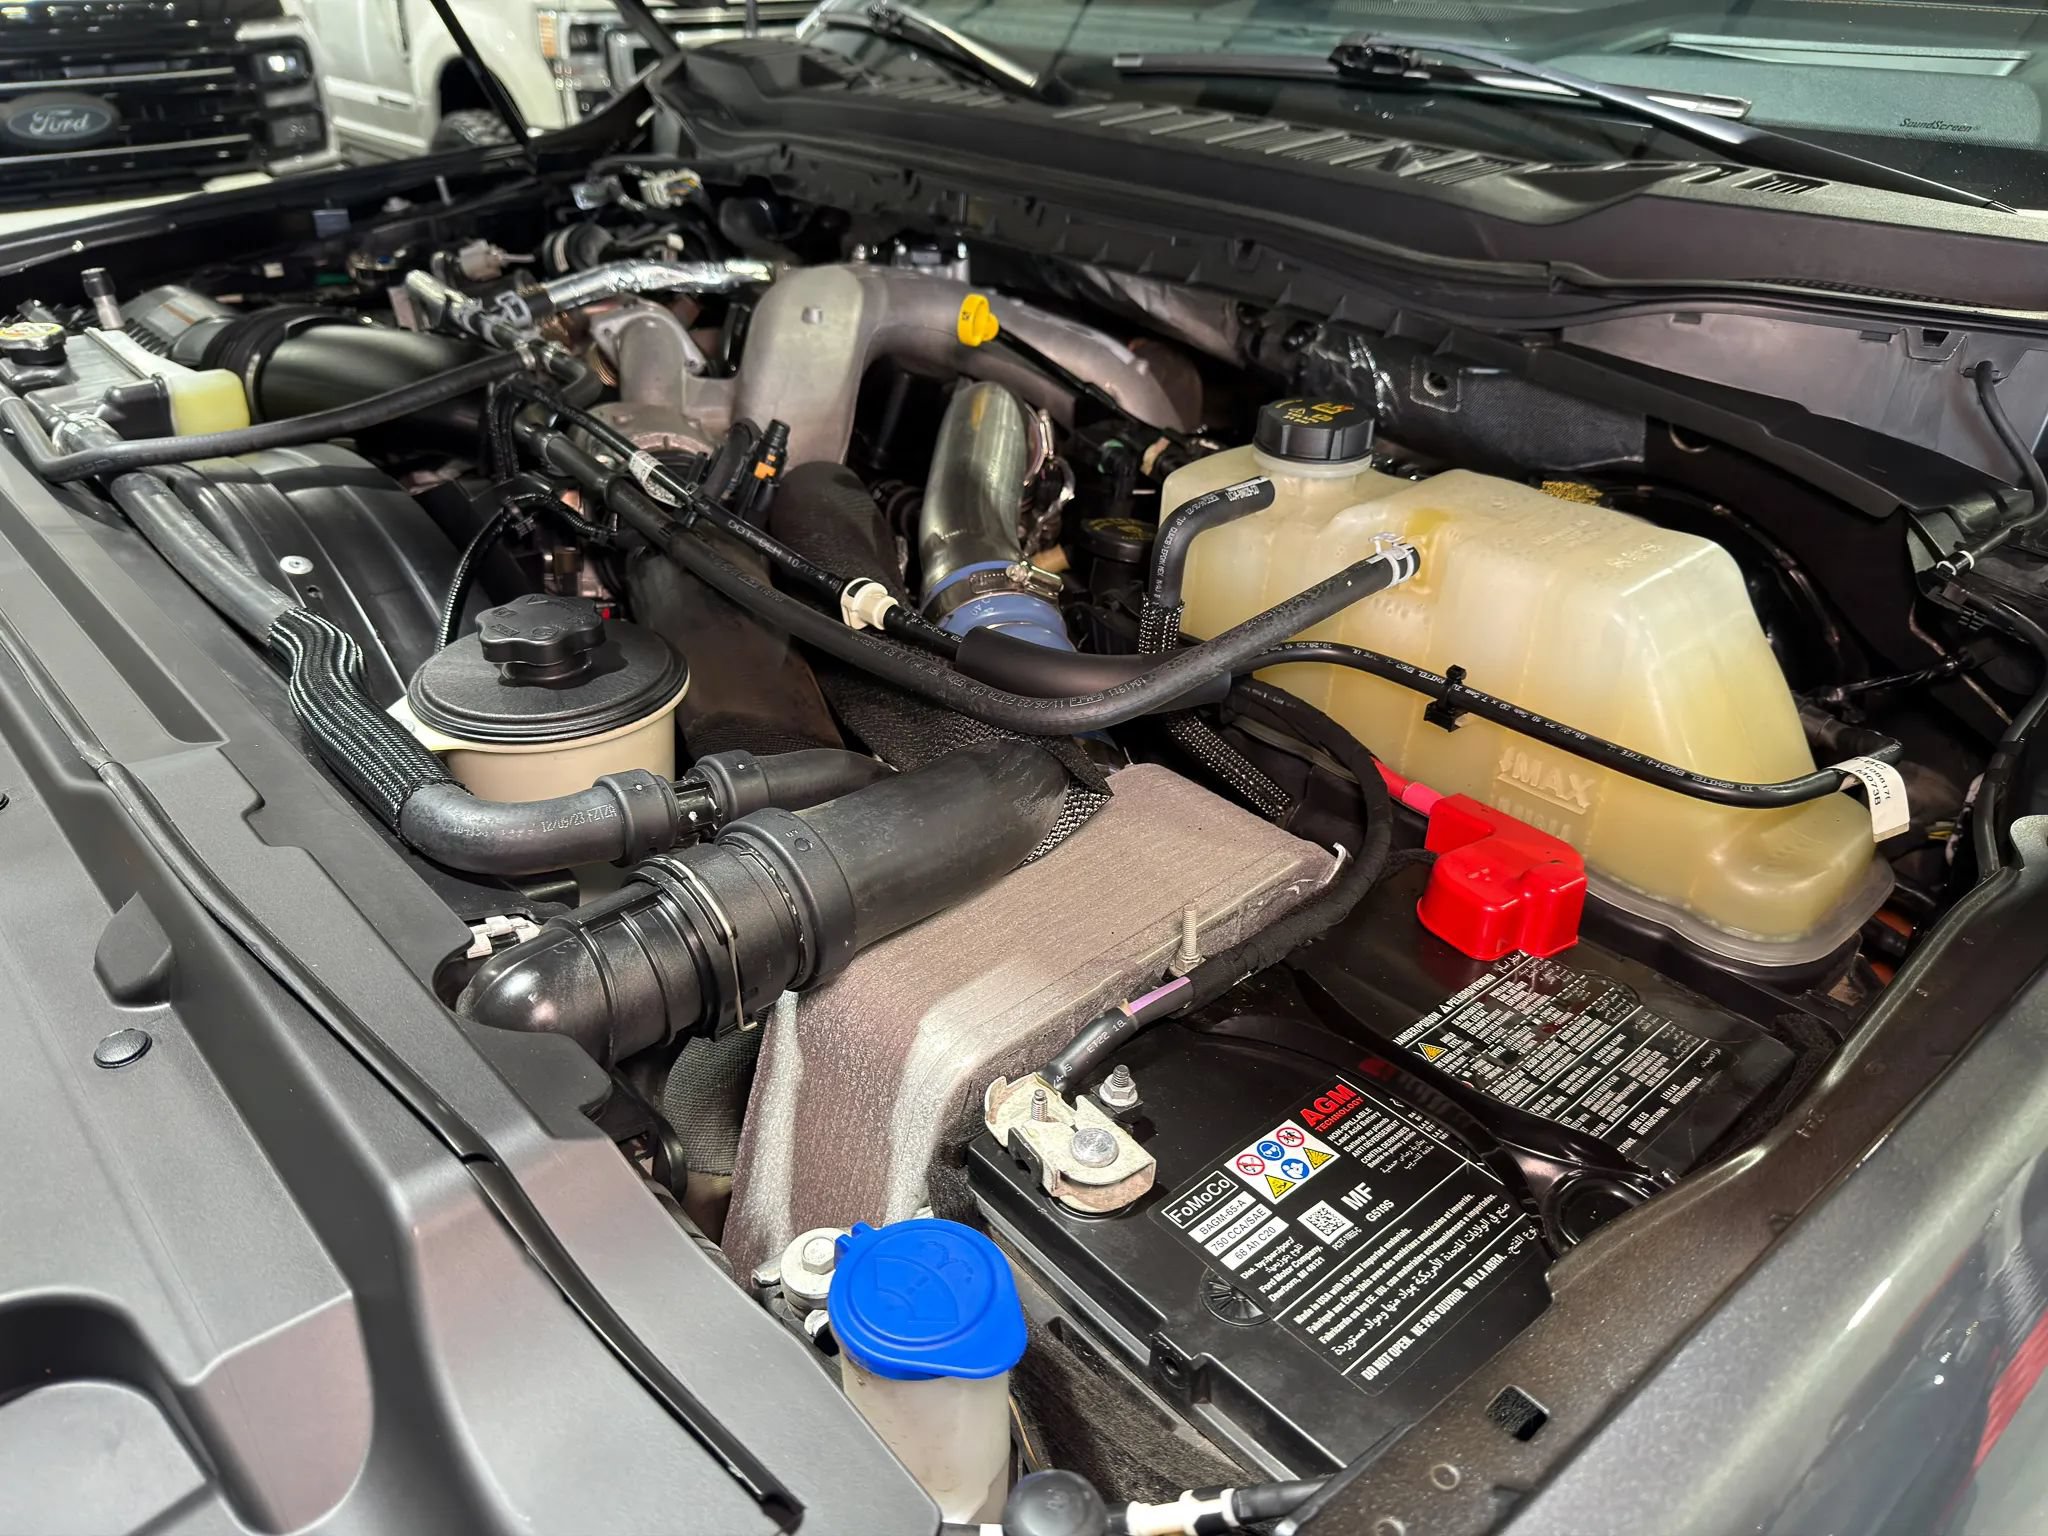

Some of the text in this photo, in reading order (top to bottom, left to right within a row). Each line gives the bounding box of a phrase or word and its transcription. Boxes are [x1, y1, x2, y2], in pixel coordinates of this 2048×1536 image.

[29, 109, 90, 136] Ford
[1300, 1084, 1355, 1126] AGM
[1315, 1096, 1362, 1131] TECHNOLOGY
[1327, 1107, 1372, 1141] NON-SPILLABLE
[1333, 1111, 1381, 1145] Lead Acid Battery
[1343, 1135, 1366, 1152] Batterie
[1371, 1117, 1389, 1132] plomb
[1351, 1145, 1366, 1157] ANTI
[1360, 1146, 1384, 1163] CONTRA
[1380, 1126, 1409, 1148] DERRAMES
[1169, 1179, 1229, 1222] FoMoCo
[1340, 1182, 1372, 1210] MF
[1365, 1199, 1394, 1221] G519S
[1495, 1203, 1510, 1218] صنع
[1199, 1199, 1246, 1234] BAGM-65-A
[1210, 1208, 1266, 1250] 750 CCA/SAE
[1464, 1218, 1489, 1242] الولايات
[1486, 1212, 1500, 1223] في
[1234, 1226, 1276, 1259] 68 Ah C20
[1349, 1309, 1360, 1319] en
[1355, 1302, 1369, 1312] los
[1364, 1294, 1379, 1304] EE.
[1374, 1285, 1389, 1296] UU.
[1386, 1275, 1399, 1286] con
[1396, 1253, 1426, 1278] materiales
[1423, 1219, 1465, 1255] estadounidenses
[1465, 1194, 1497, 1218] importados.
[1439, 1238, 1466, 1261] المتحدة
[1239, 1267, 1258, 1279] Dist.
[1258, 1245, 1323, 1293] Ford Motor Company,
[1267, 1256, 1324, 1301] Dearborn, MI 48121
[1293, 1228, 1412, 1324] Made in USA with US and imported materials.
[1305, 1194, 1474, 1333] Fabriqué aux États-Unis avec des matériaux américains et importés.
[1360, 1253, 1507, 1380] DO NOT OPEN. NE PAS OUVRIR. NO LA ABRA.
[1364, 1311, 1389, 1329] ومواد
[1330, 1328, 1366, 1355] مستوردة
